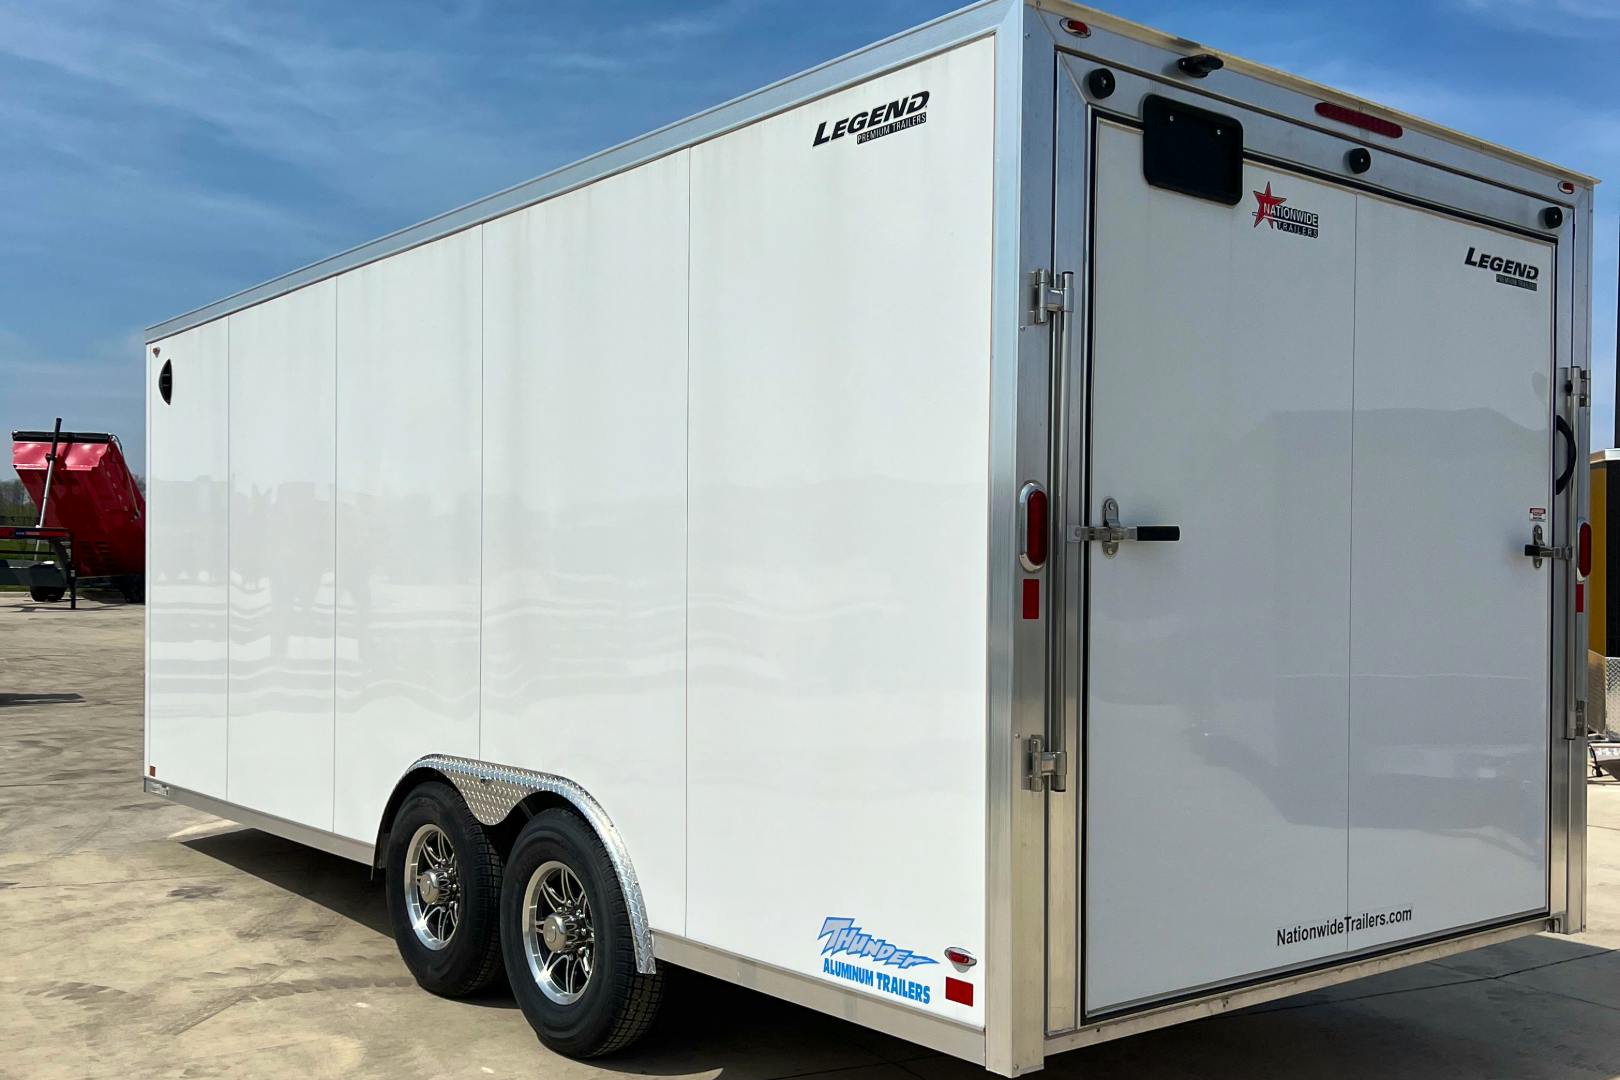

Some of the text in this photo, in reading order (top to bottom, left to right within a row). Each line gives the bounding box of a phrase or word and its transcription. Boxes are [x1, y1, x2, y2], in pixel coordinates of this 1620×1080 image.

[812, 90, 930, 147] LEGEND
[857, 112, 926, 144] PREMIUM TRAILERS
[1263, 202, 1318, 226] NATIONWIDE
[1277, 220, 1318, 238] TRAILERS
[1464, 246, 1539, 280] LEGEND
[1276, 908, 1412, 946] NationwideTrailers.com
[823, 957, 931, 1005] ALUMINUM TRAILERS
